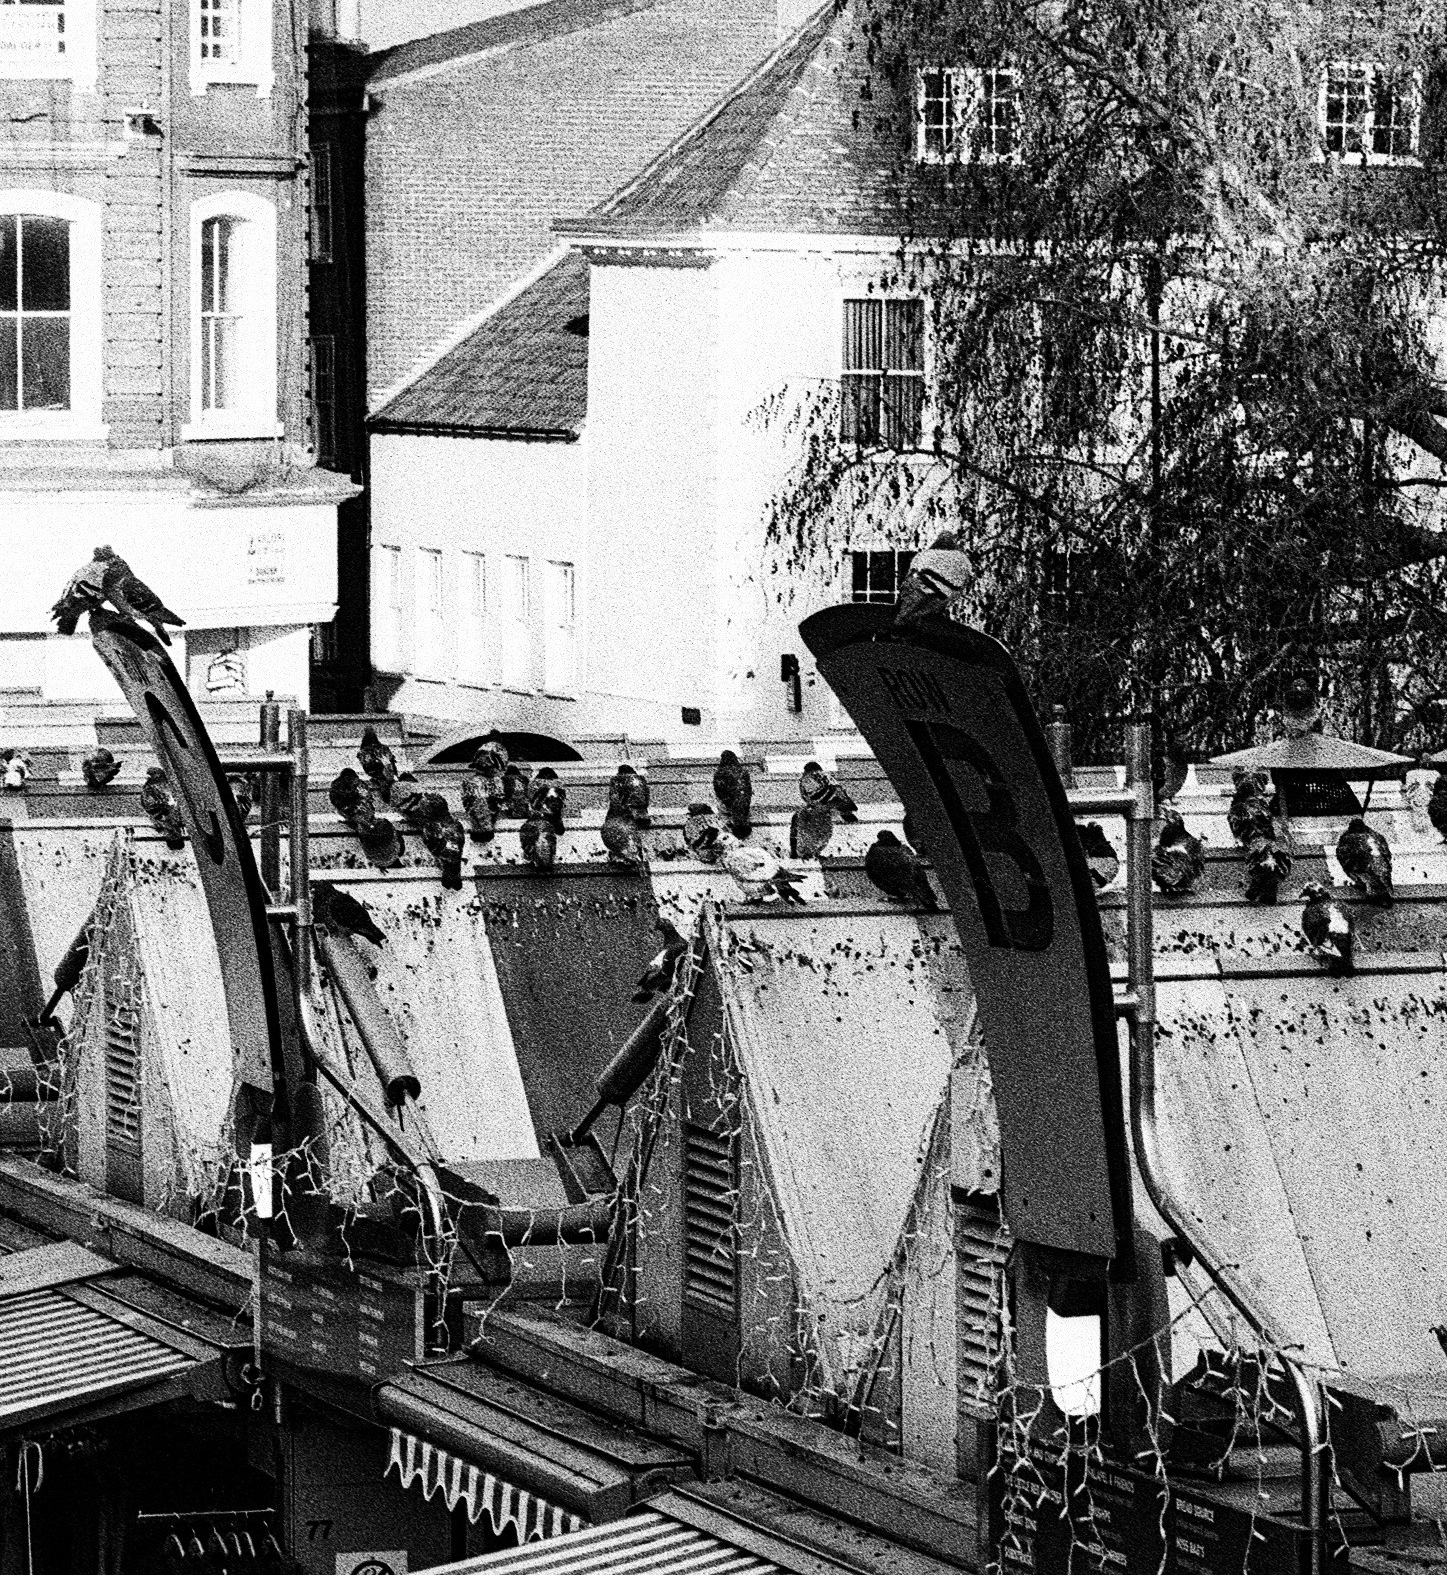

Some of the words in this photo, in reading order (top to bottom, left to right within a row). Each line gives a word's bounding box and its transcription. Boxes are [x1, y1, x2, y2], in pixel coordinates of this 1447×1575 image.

[876, 666, 951, 713] ROW
[903, 719, 1054, 952] B
[306, 1520, 334, 1541] 77
